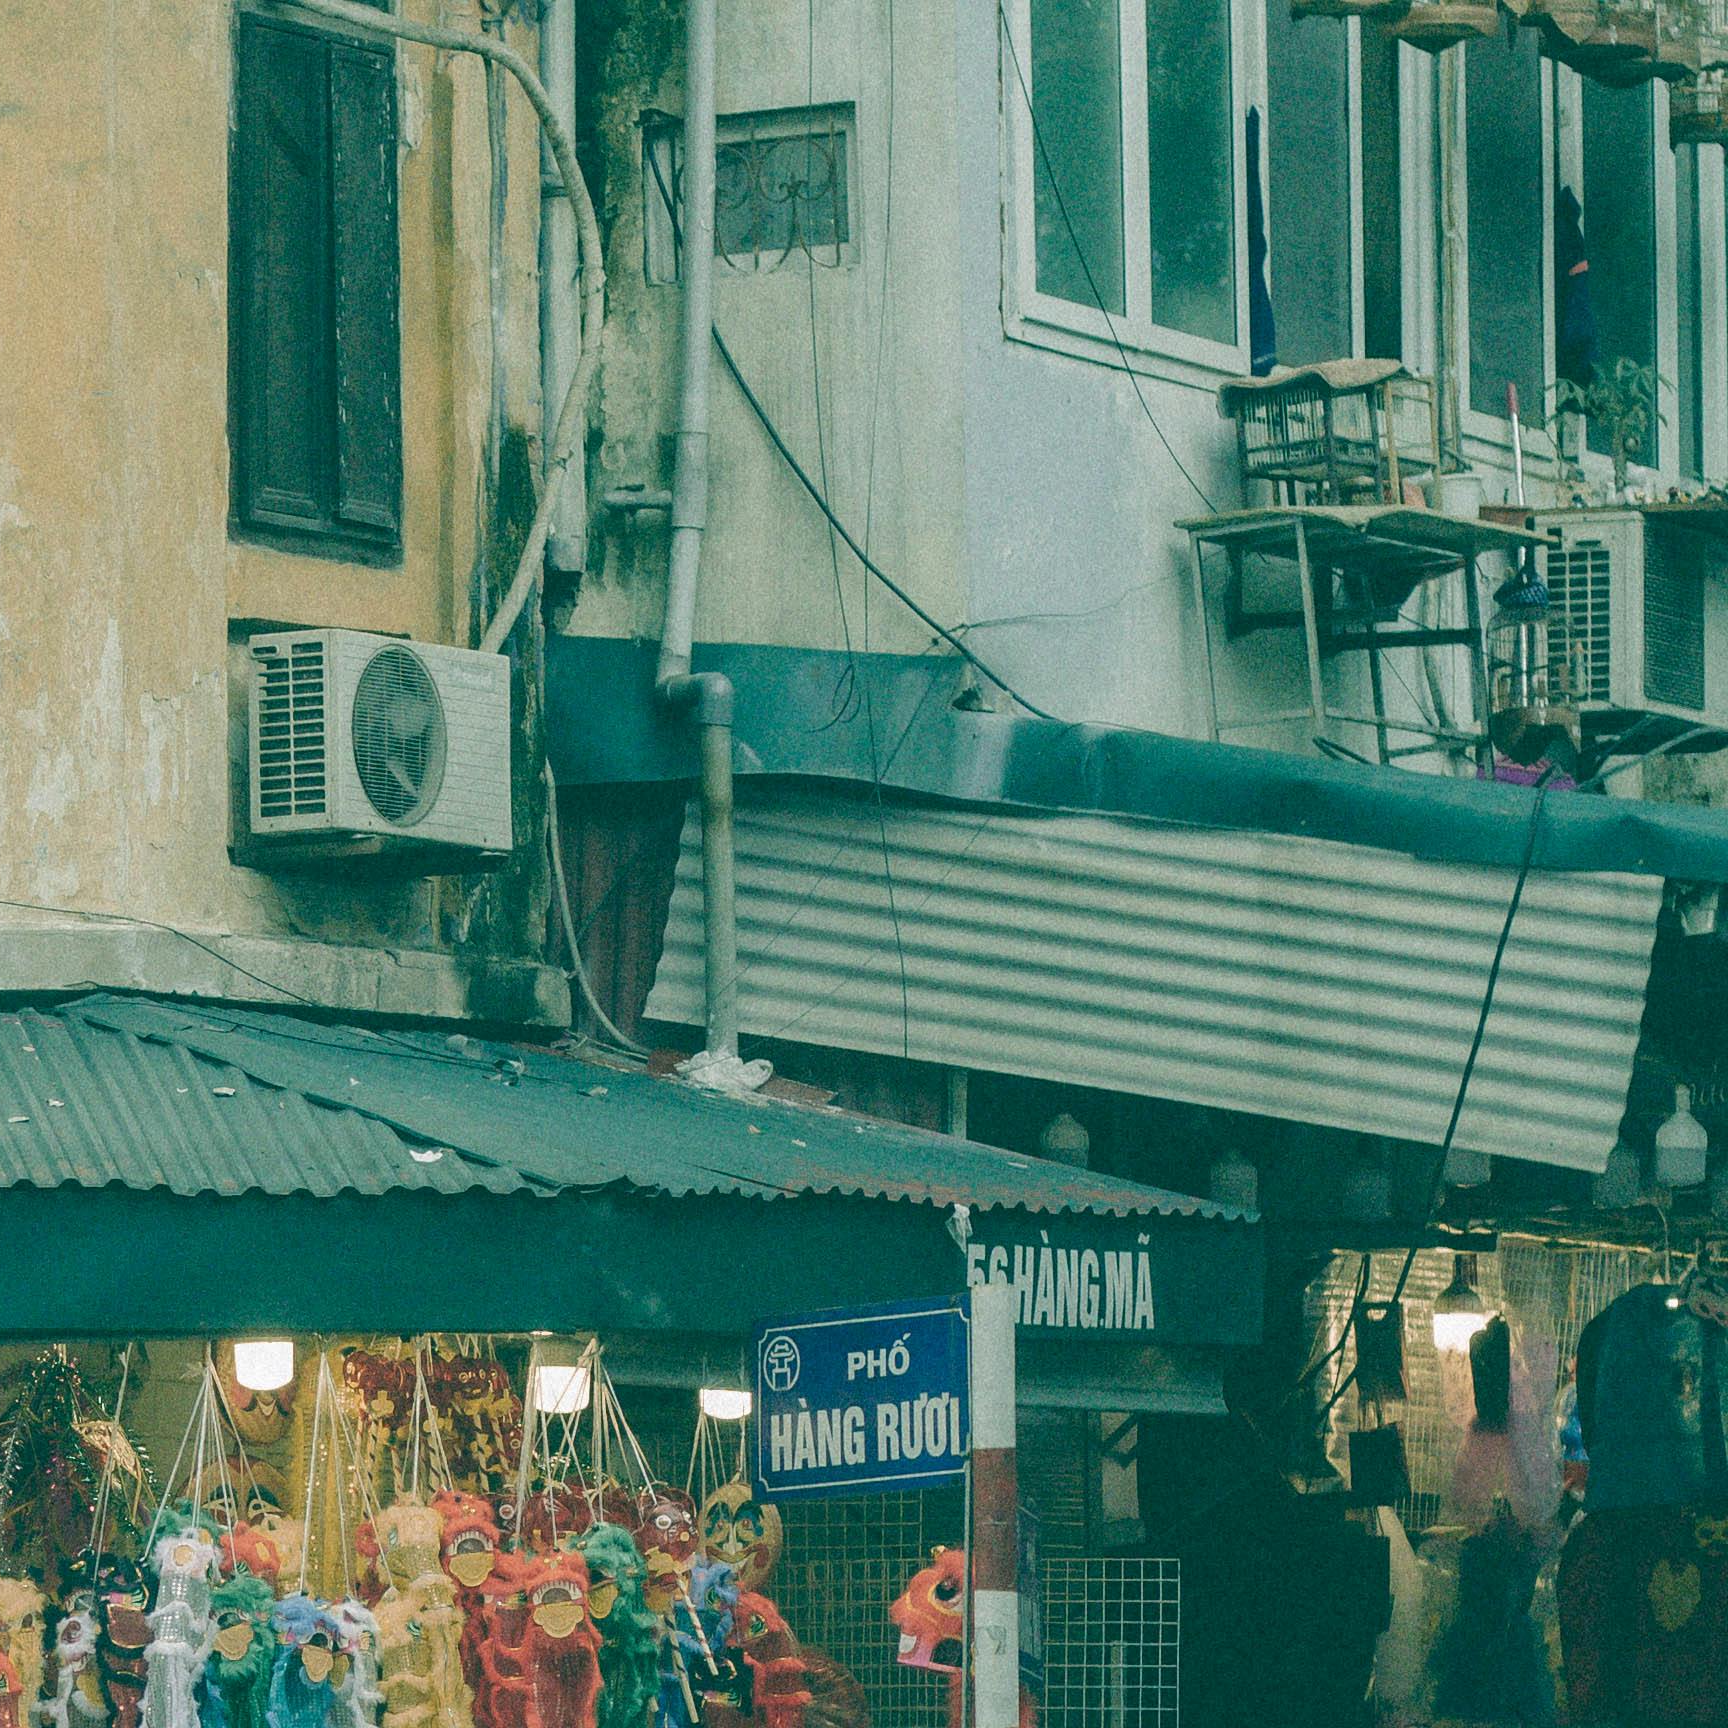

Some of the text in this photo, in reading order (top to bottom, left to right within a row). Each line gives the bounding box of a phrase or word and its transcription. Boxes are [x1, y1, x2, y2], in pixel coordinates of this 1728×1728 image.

[847, 1332, 912, 1380] PHỐ
[770, 1391, 960, 1472] HÀNG RƯƠI
